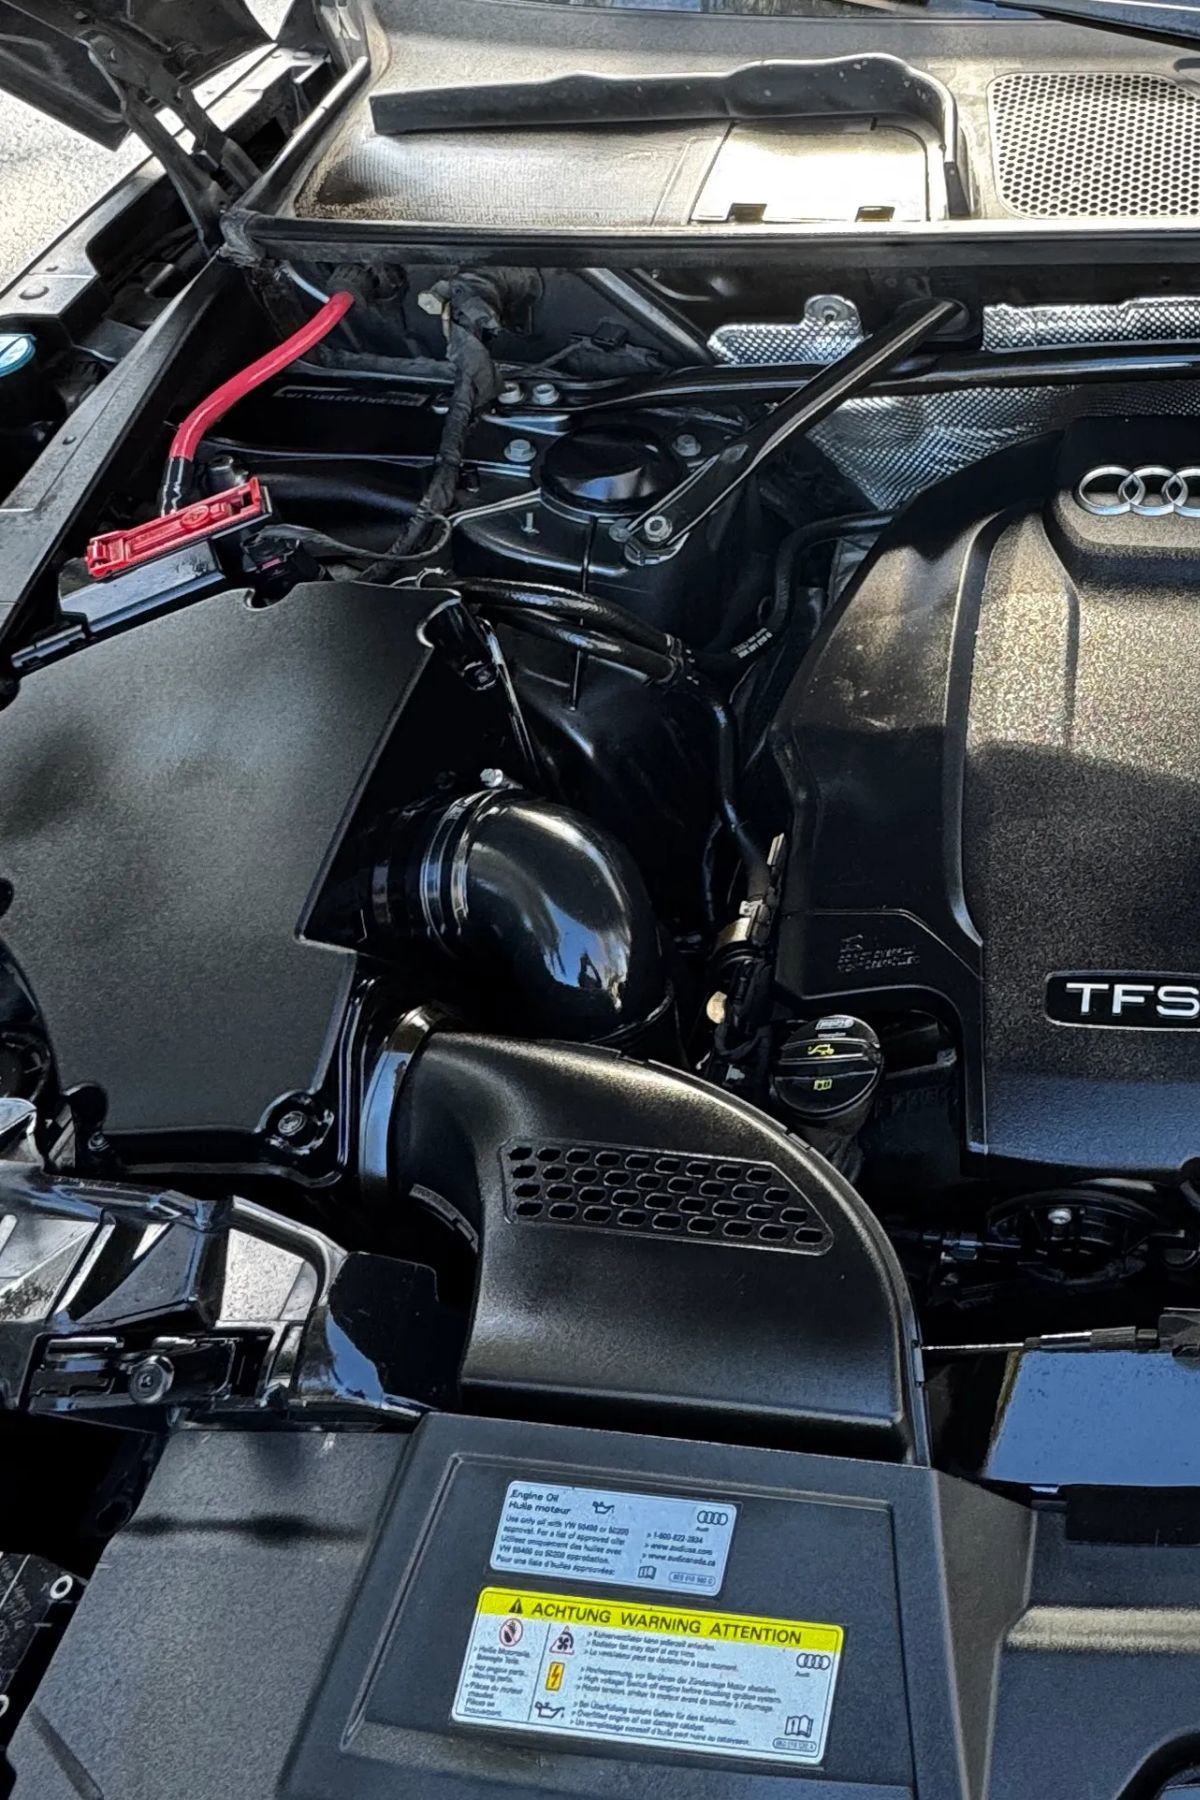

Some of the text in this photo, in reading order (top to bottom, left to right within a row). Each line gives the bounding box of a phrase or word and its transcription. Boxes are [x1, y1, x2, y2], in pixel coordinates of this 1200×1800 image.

[509, 1489, 559, 1502] Engine Oil
[508, 1501, 571, 1514] Huile moteur
[531, 1603, 802, 1645] ACHTUNG WARNING ATTENTION
